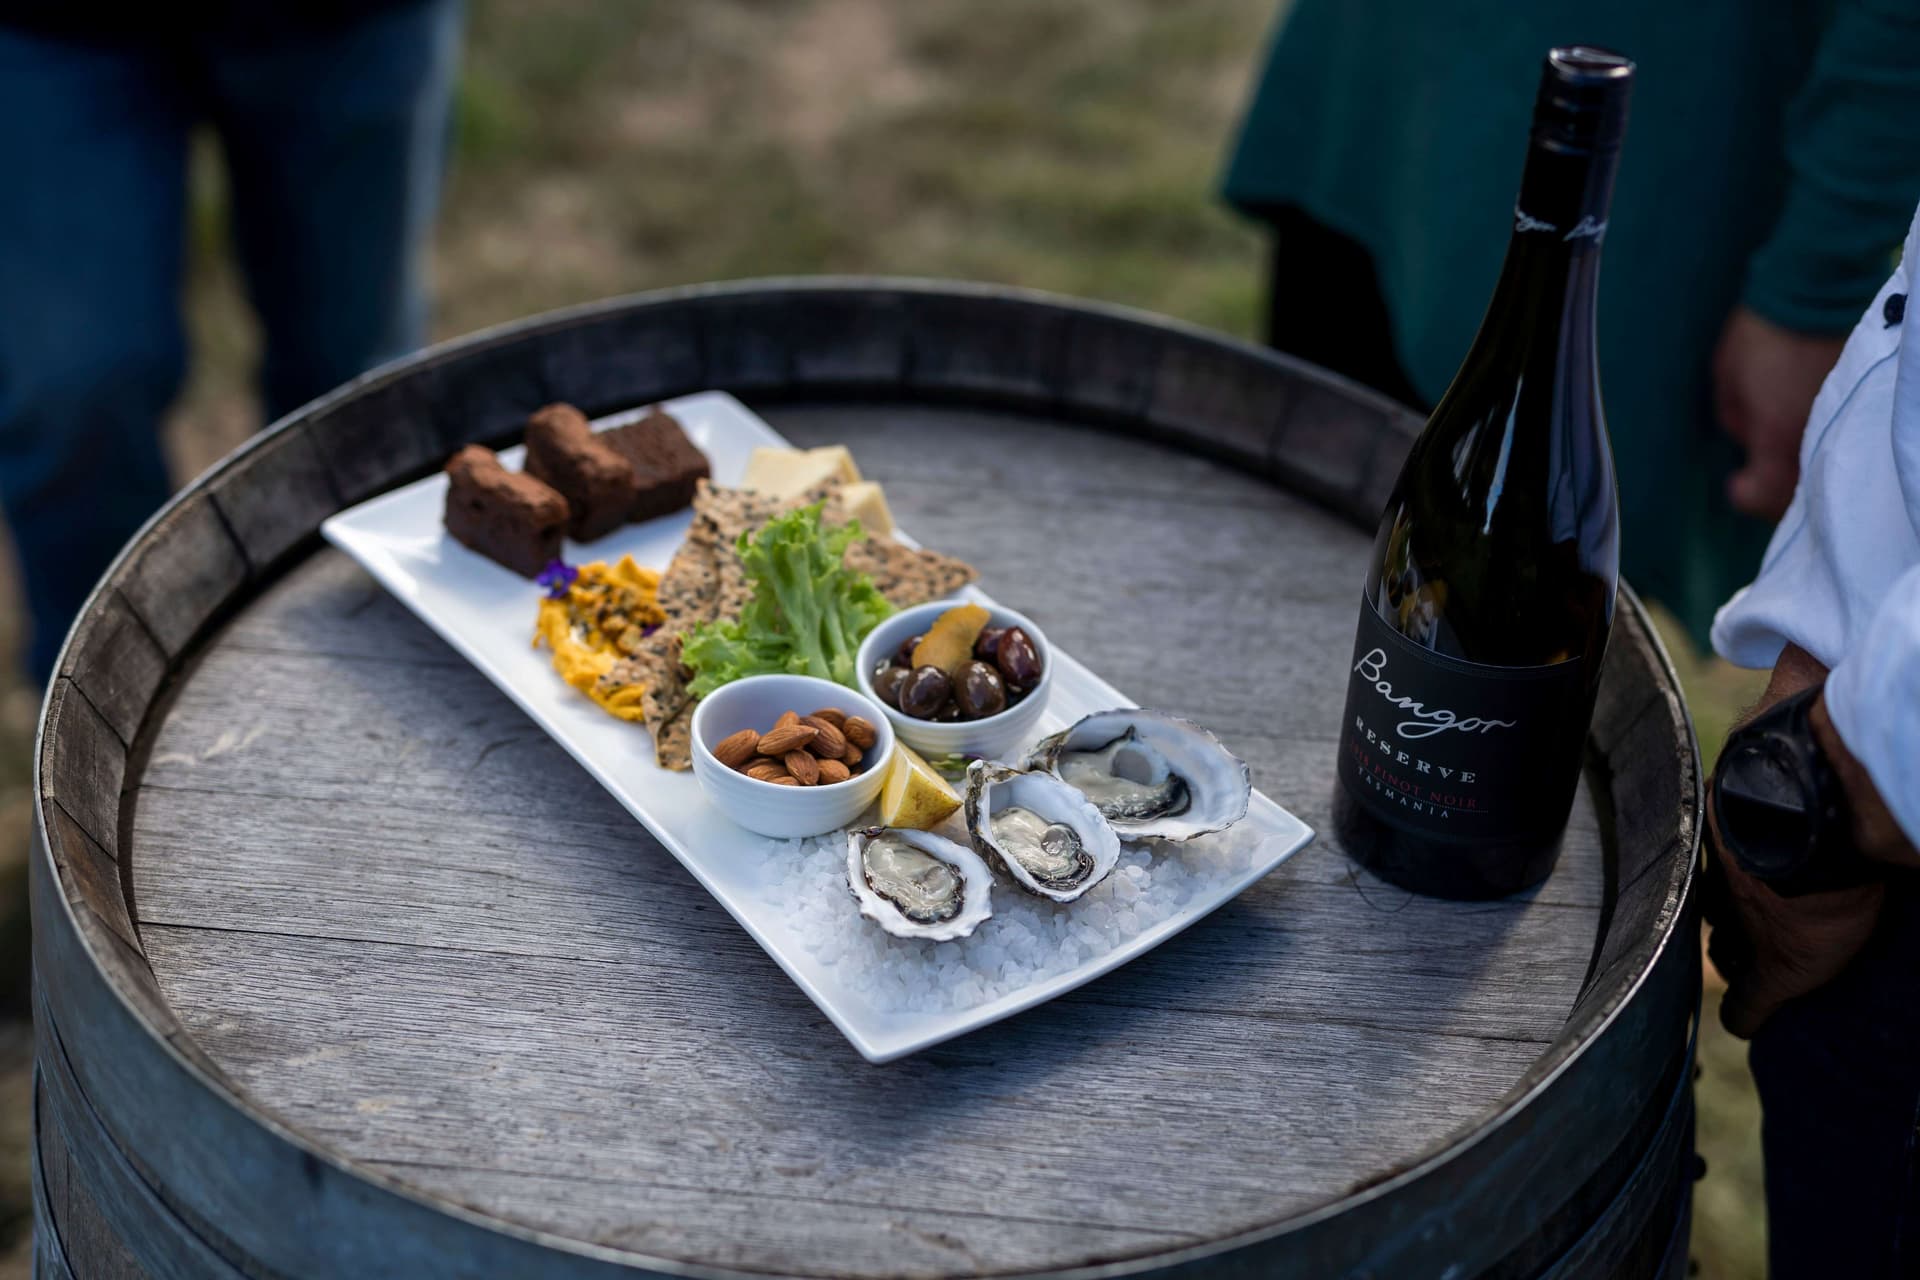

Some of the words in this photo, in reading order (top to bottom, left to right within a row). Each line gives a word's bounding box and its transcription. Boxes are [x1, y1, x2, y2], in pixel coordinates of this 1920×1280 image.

[1353, 647, 1517, 739] Bangor
[1355, 715, 1477, 784] RESERVE
[1357, 767, 1449, 819] TASMANIA
[1374, 760, 1420, 796] PINOT
[1429, 791, 1478, 810] NOIR
